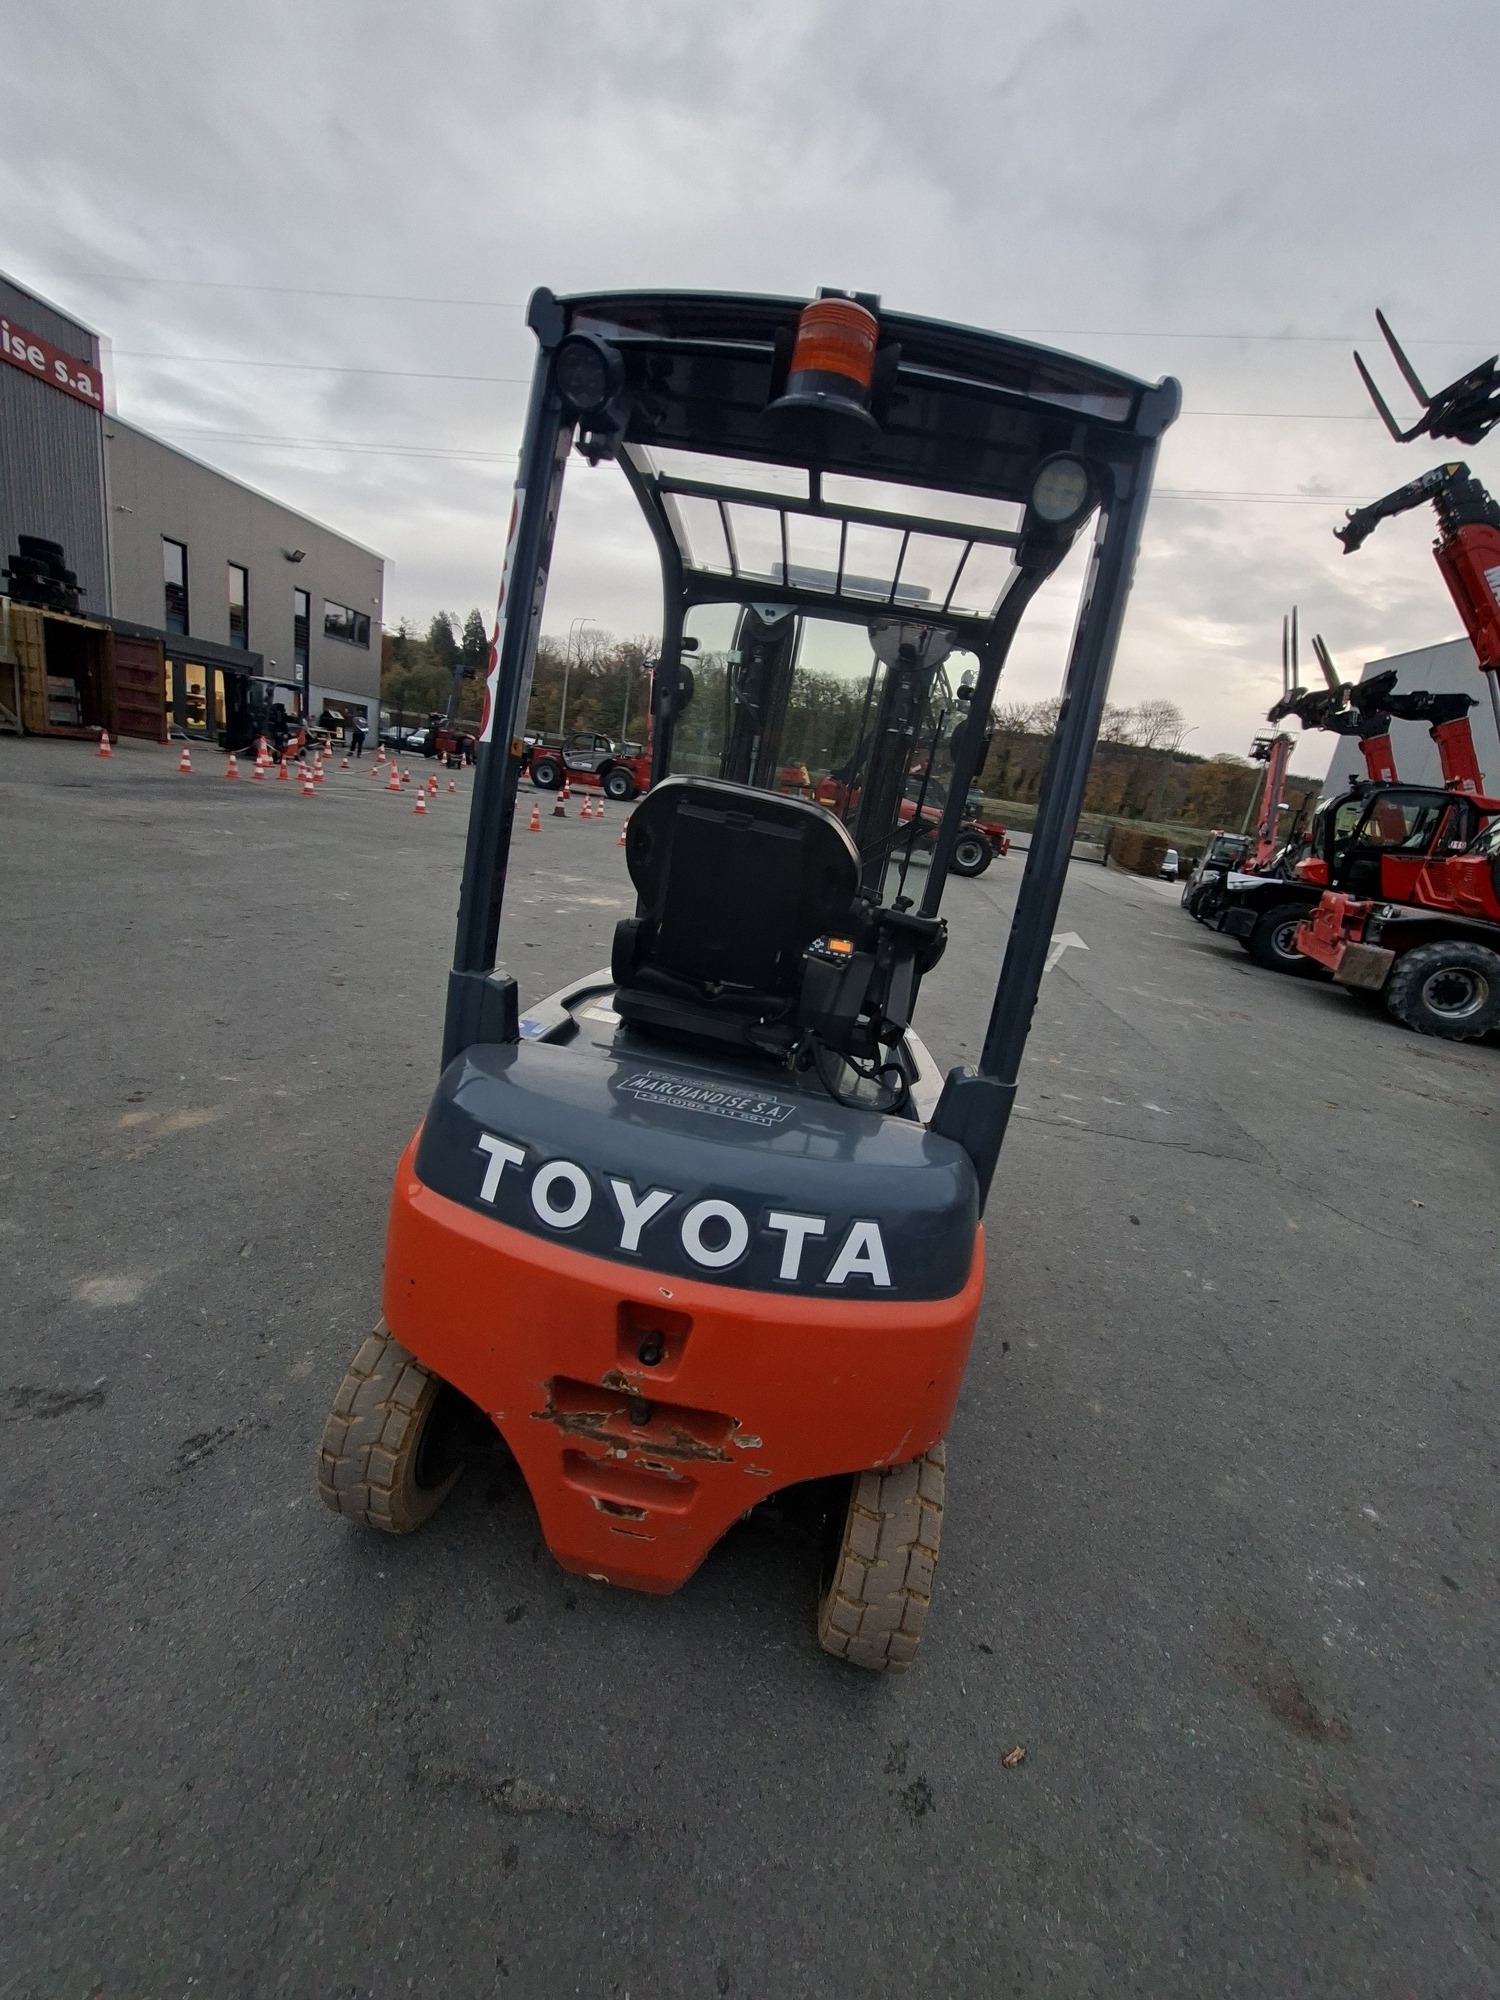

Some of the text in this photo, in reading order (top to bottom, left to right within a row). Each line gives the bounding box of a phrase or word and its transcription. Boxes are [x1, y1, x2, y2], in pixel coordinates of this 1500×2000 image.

[1, 319, 101, 401] ise s.a.
[628, 1077, 752, 1110] MARCHANDISE
[751, 1102, 782, 1118] S.A.
[478, 1133, 892, 1287] TOYOTA
